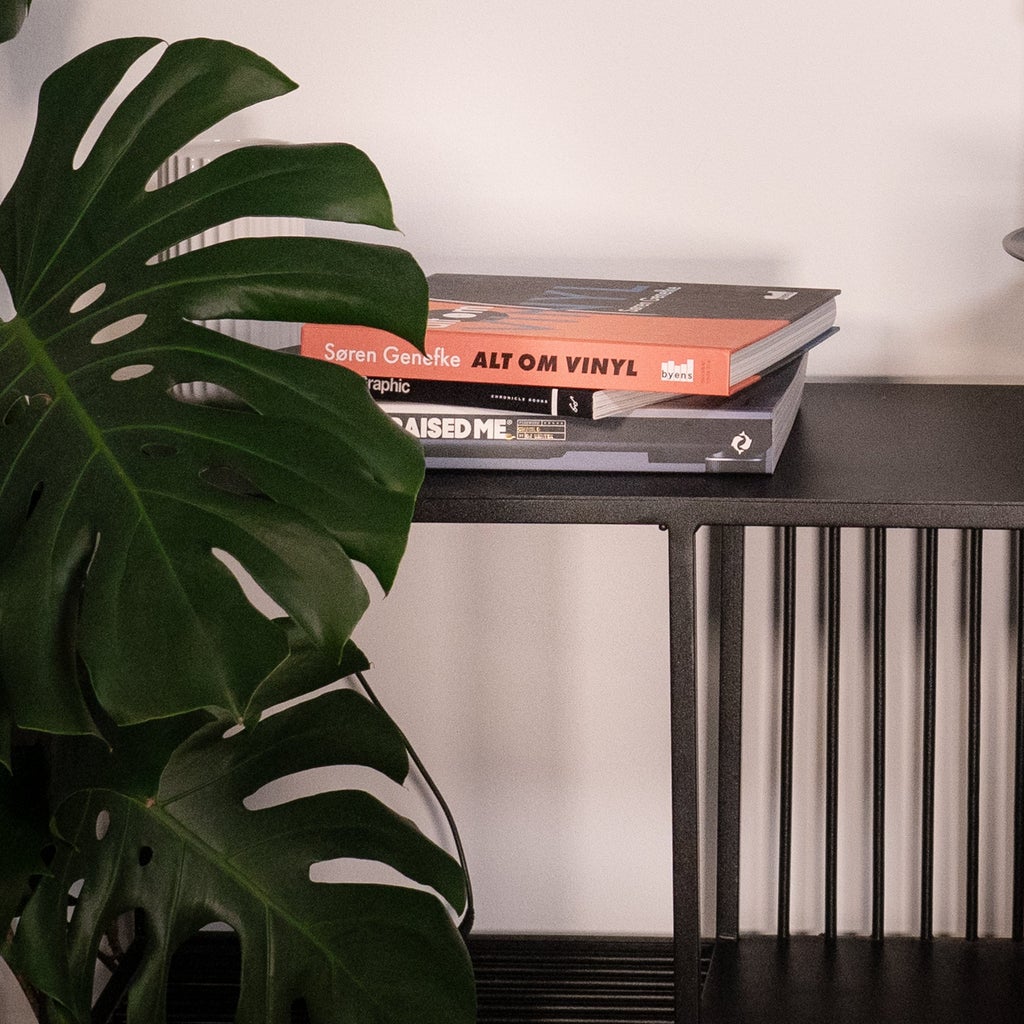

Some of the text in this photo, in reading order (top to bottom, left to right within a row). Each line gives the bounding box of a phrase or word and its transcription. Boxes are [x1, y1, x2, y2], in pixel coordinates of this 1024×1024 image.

[324, 342, 377, 364] Søren
[472, 351, 638, 376] ALT OM VINYL
[661, 369, 694, 380] byens
[365, 376, 411, 394] raphic
[490, 394, 526, 402] CHRONICLE
[392, 417, 472, 439] AISED
